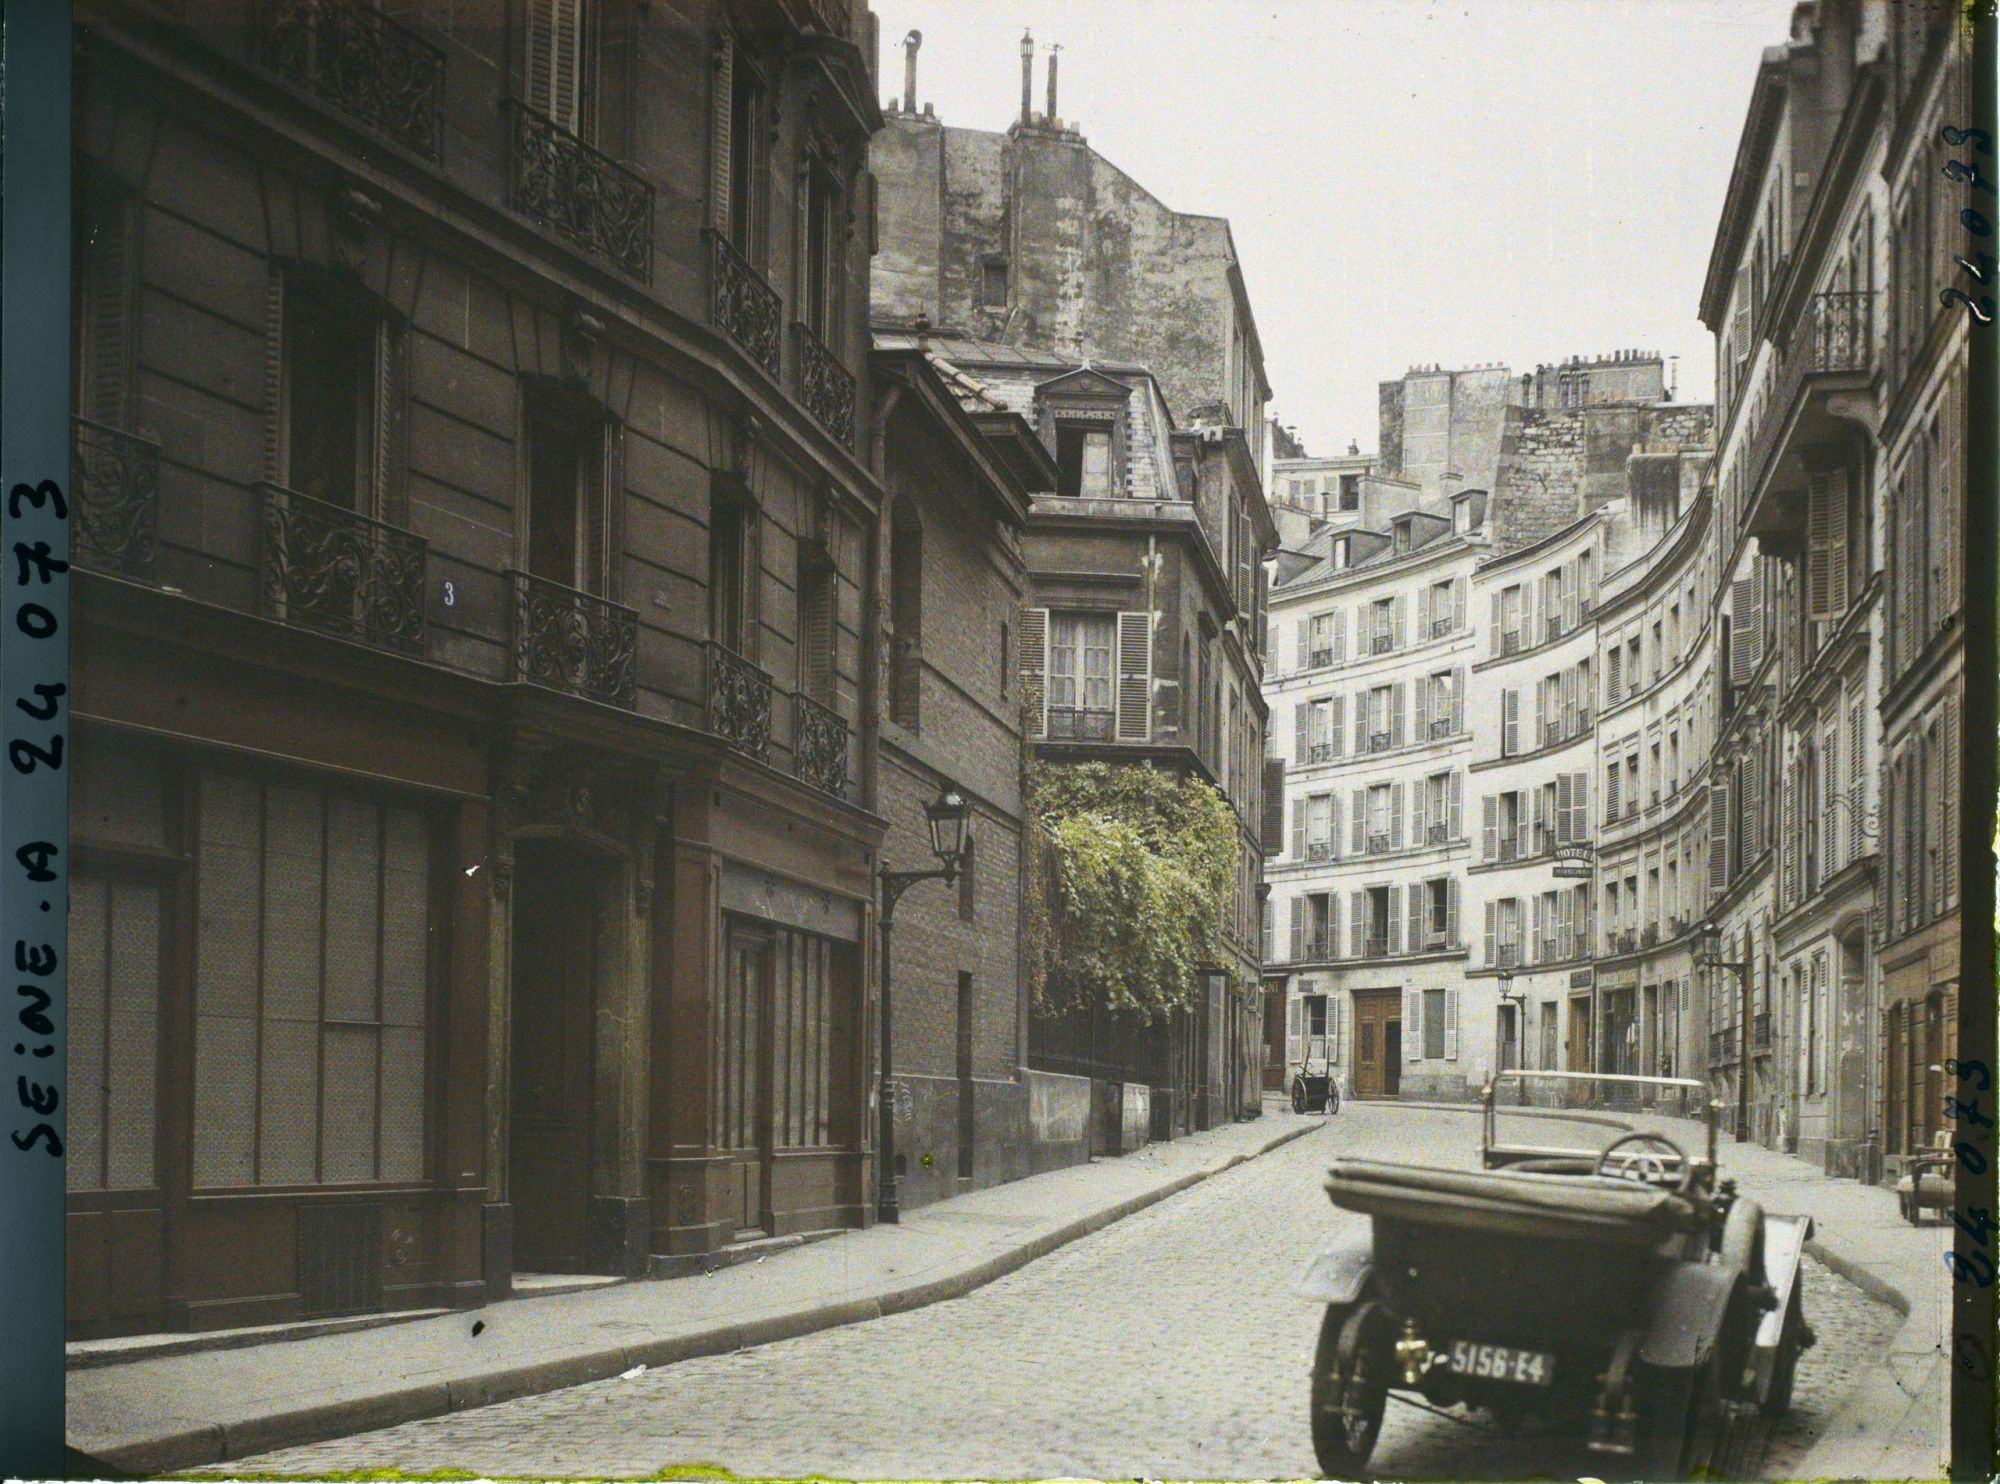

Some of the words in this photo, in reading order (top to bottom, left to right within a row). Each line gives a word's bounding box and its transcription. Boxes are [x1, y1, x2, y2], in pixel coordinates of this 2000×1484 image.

[10, 480, 67, 640] 073
[444, 581, 455, 606] 3
[9, 683, 66, 775] 24
